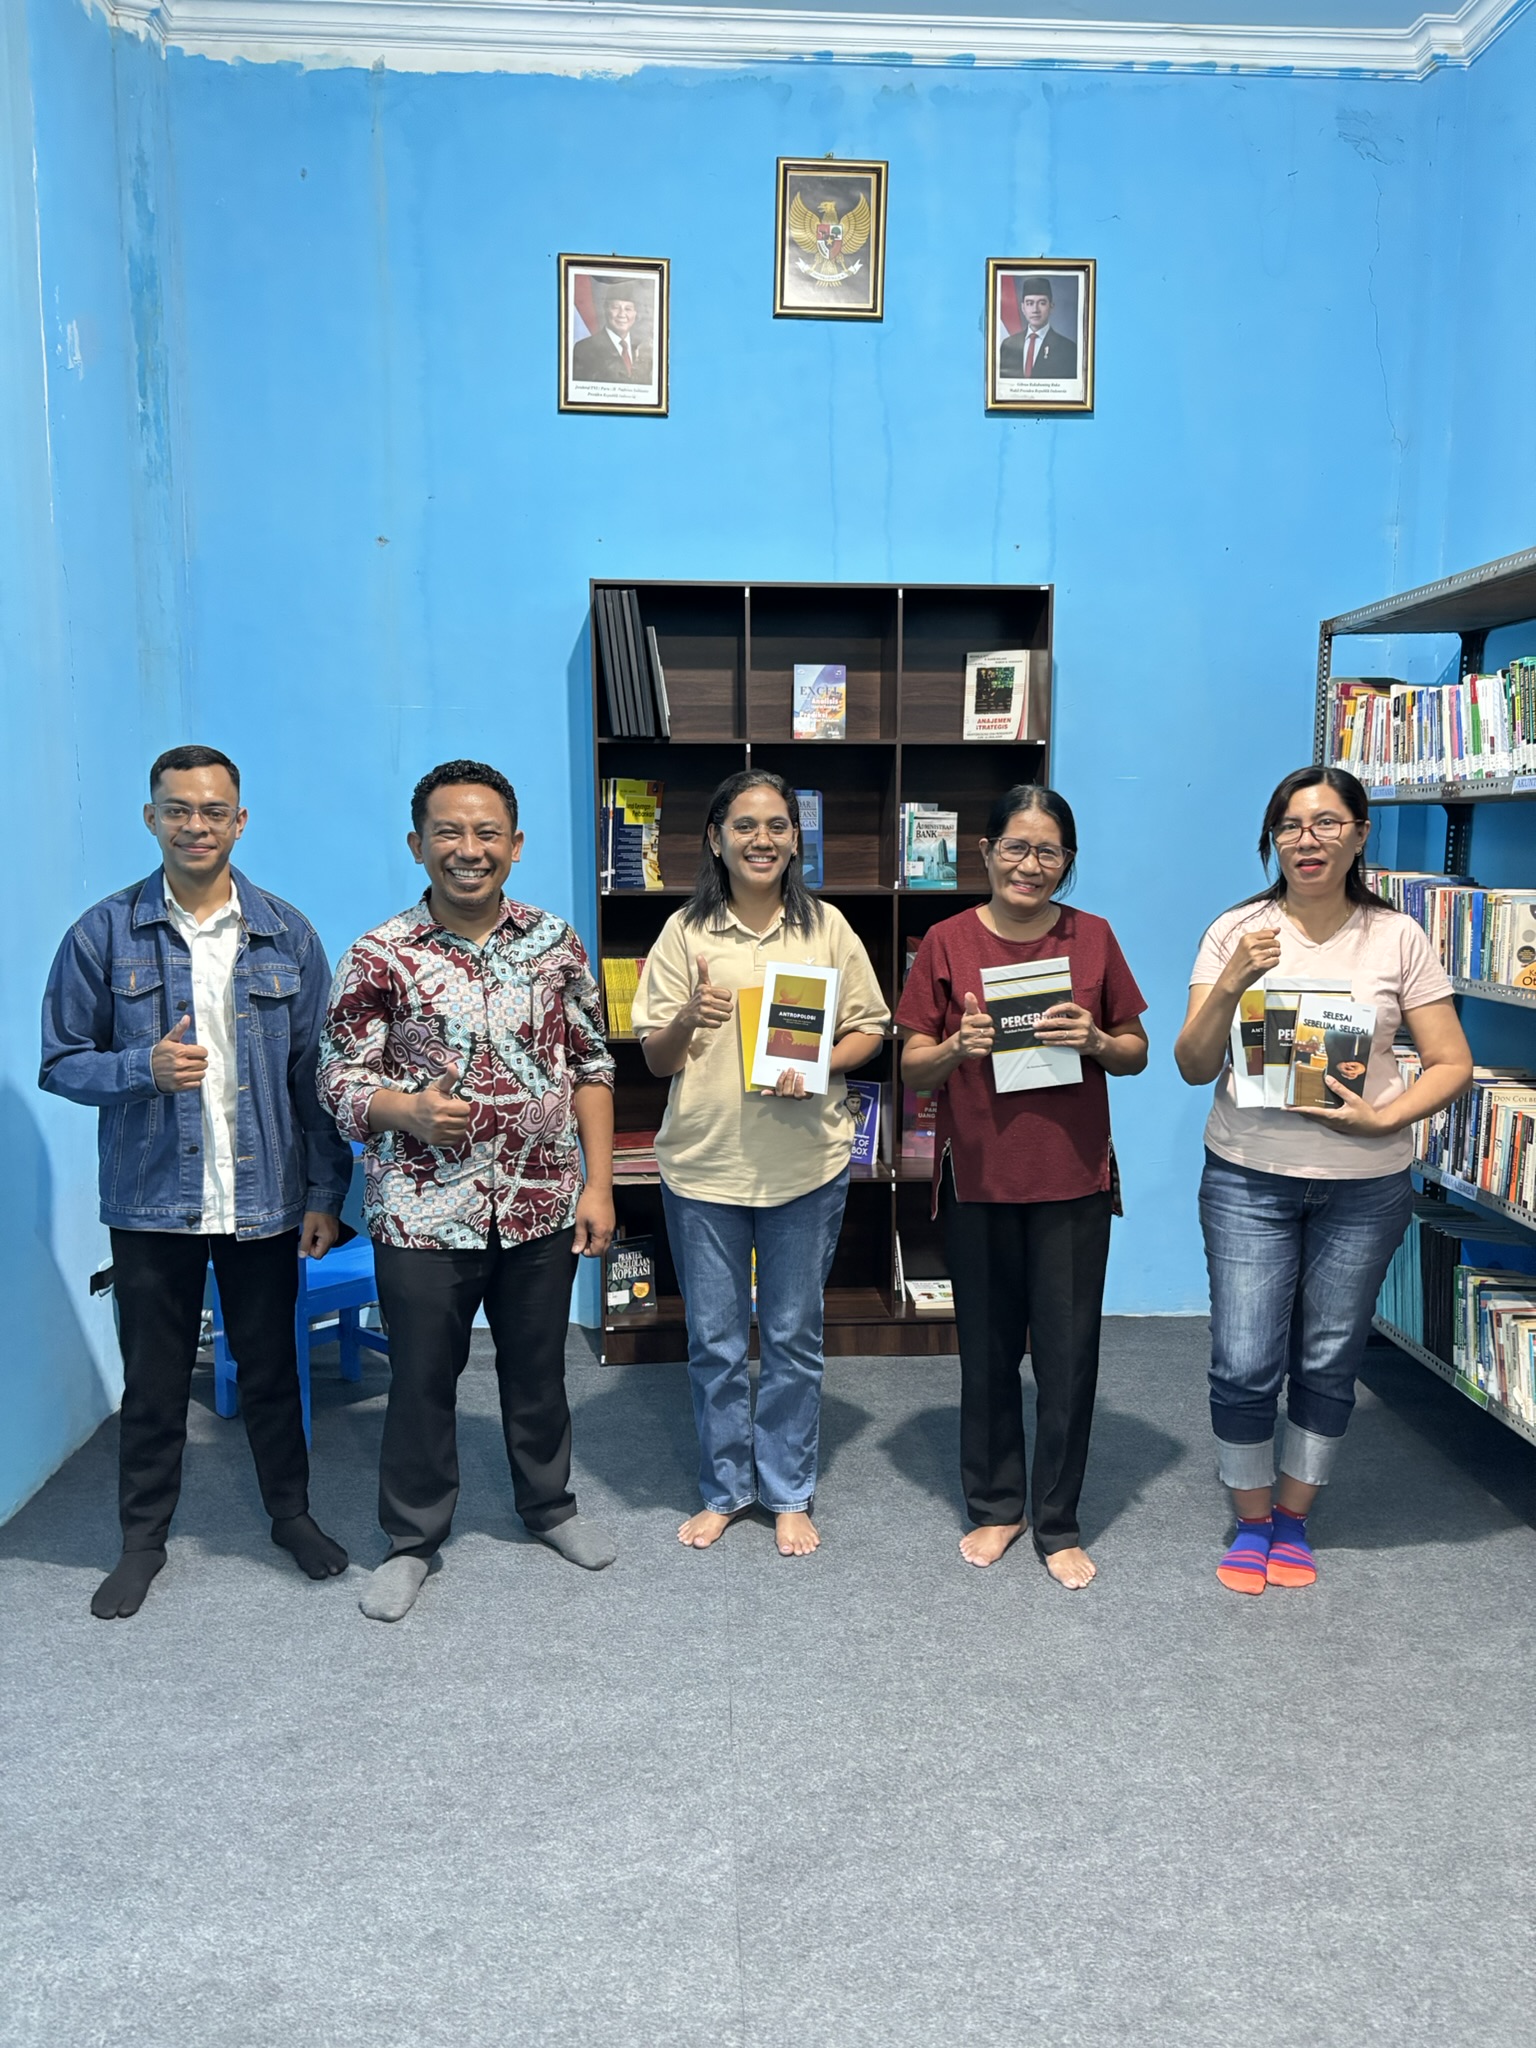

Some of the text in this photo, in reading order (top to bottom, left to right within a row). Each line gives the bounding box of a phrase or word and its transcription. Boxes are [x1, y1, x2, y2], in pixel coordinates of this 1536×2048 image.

[800, 686, 838, 696] EXCEL
[916, 822, 955, 830] ADMINISTRASI
[916, 829, 938, 838] BANK
[778, 1011, 816, 1021] ANTROPOLOGI
[1001, 1012, 1067, 1028] PERCER
[1323, 1010, 1353, 1022] SELESAI
[1303, 1018, 1369, 1036] SEBELUM SELESAI
[1493, 1095, 1511, 1103] DON
[858, 1139, 870, 1147] OF
[851, 1147, 868, 1156] BOX
[618, 1251, 643, 1261] PRAKTEK
[612, 1265, 651, 1281] KOPERASI
